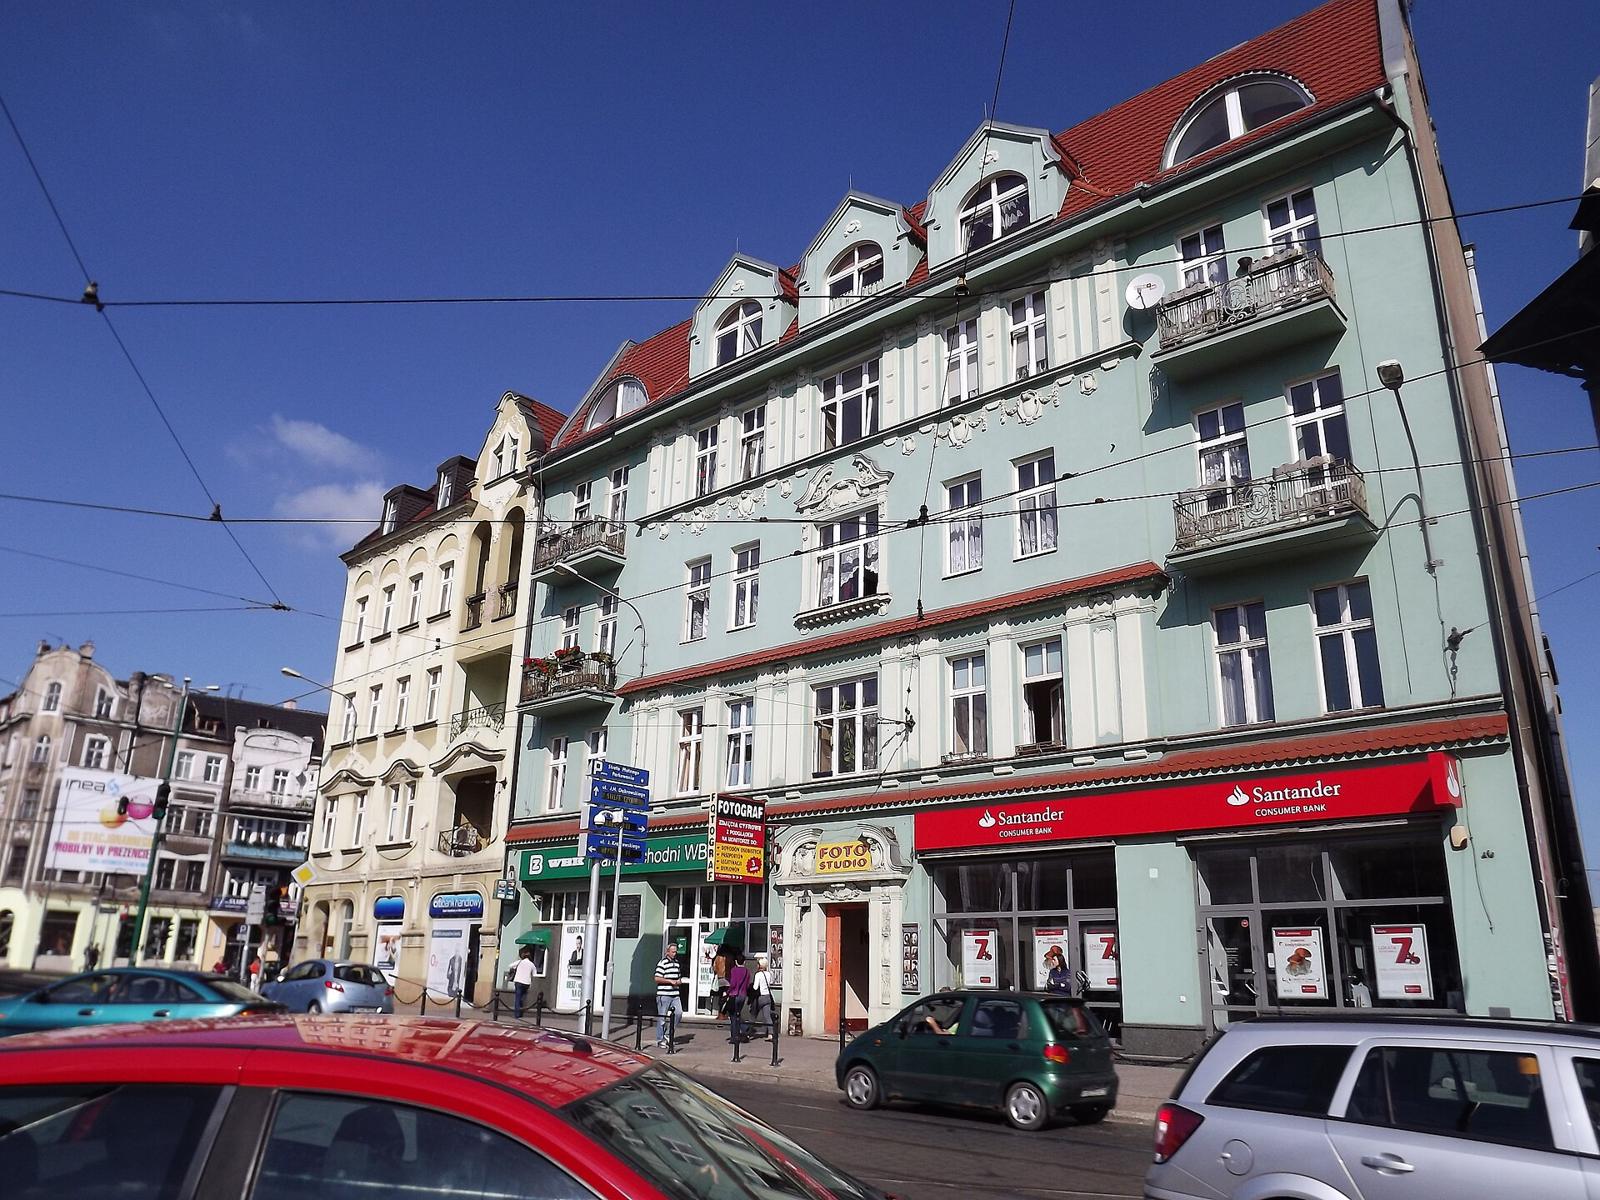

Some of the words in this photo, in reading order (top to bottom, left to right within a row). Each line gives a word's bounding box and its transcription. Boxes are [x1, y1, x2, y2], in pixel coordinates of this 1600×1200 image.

[65, 778, 106, 793] inea
[1252, 780, 1342, 803] Santander
[717, 799, 764, 819] FOTOGRAF
[998, 806, 1065, 826] Santander
[1255, 805, 1301, 817] CONSUMER
[1303, 803, 1327, 813] BANK
[706, 792, 717, 881] FOTOGRAF
[999, 828, 1034, 838] CONSUMER
[1034, 826, 1052, 835] BANK
[53, 841, 94, 855] MOBILNY
[96, 844, 105, 856] W
[108, 846, 150, 859] PREZENCIE
[819, 844, 868, 859] FOTO
[819, 858, 867, 870] STUDIO
